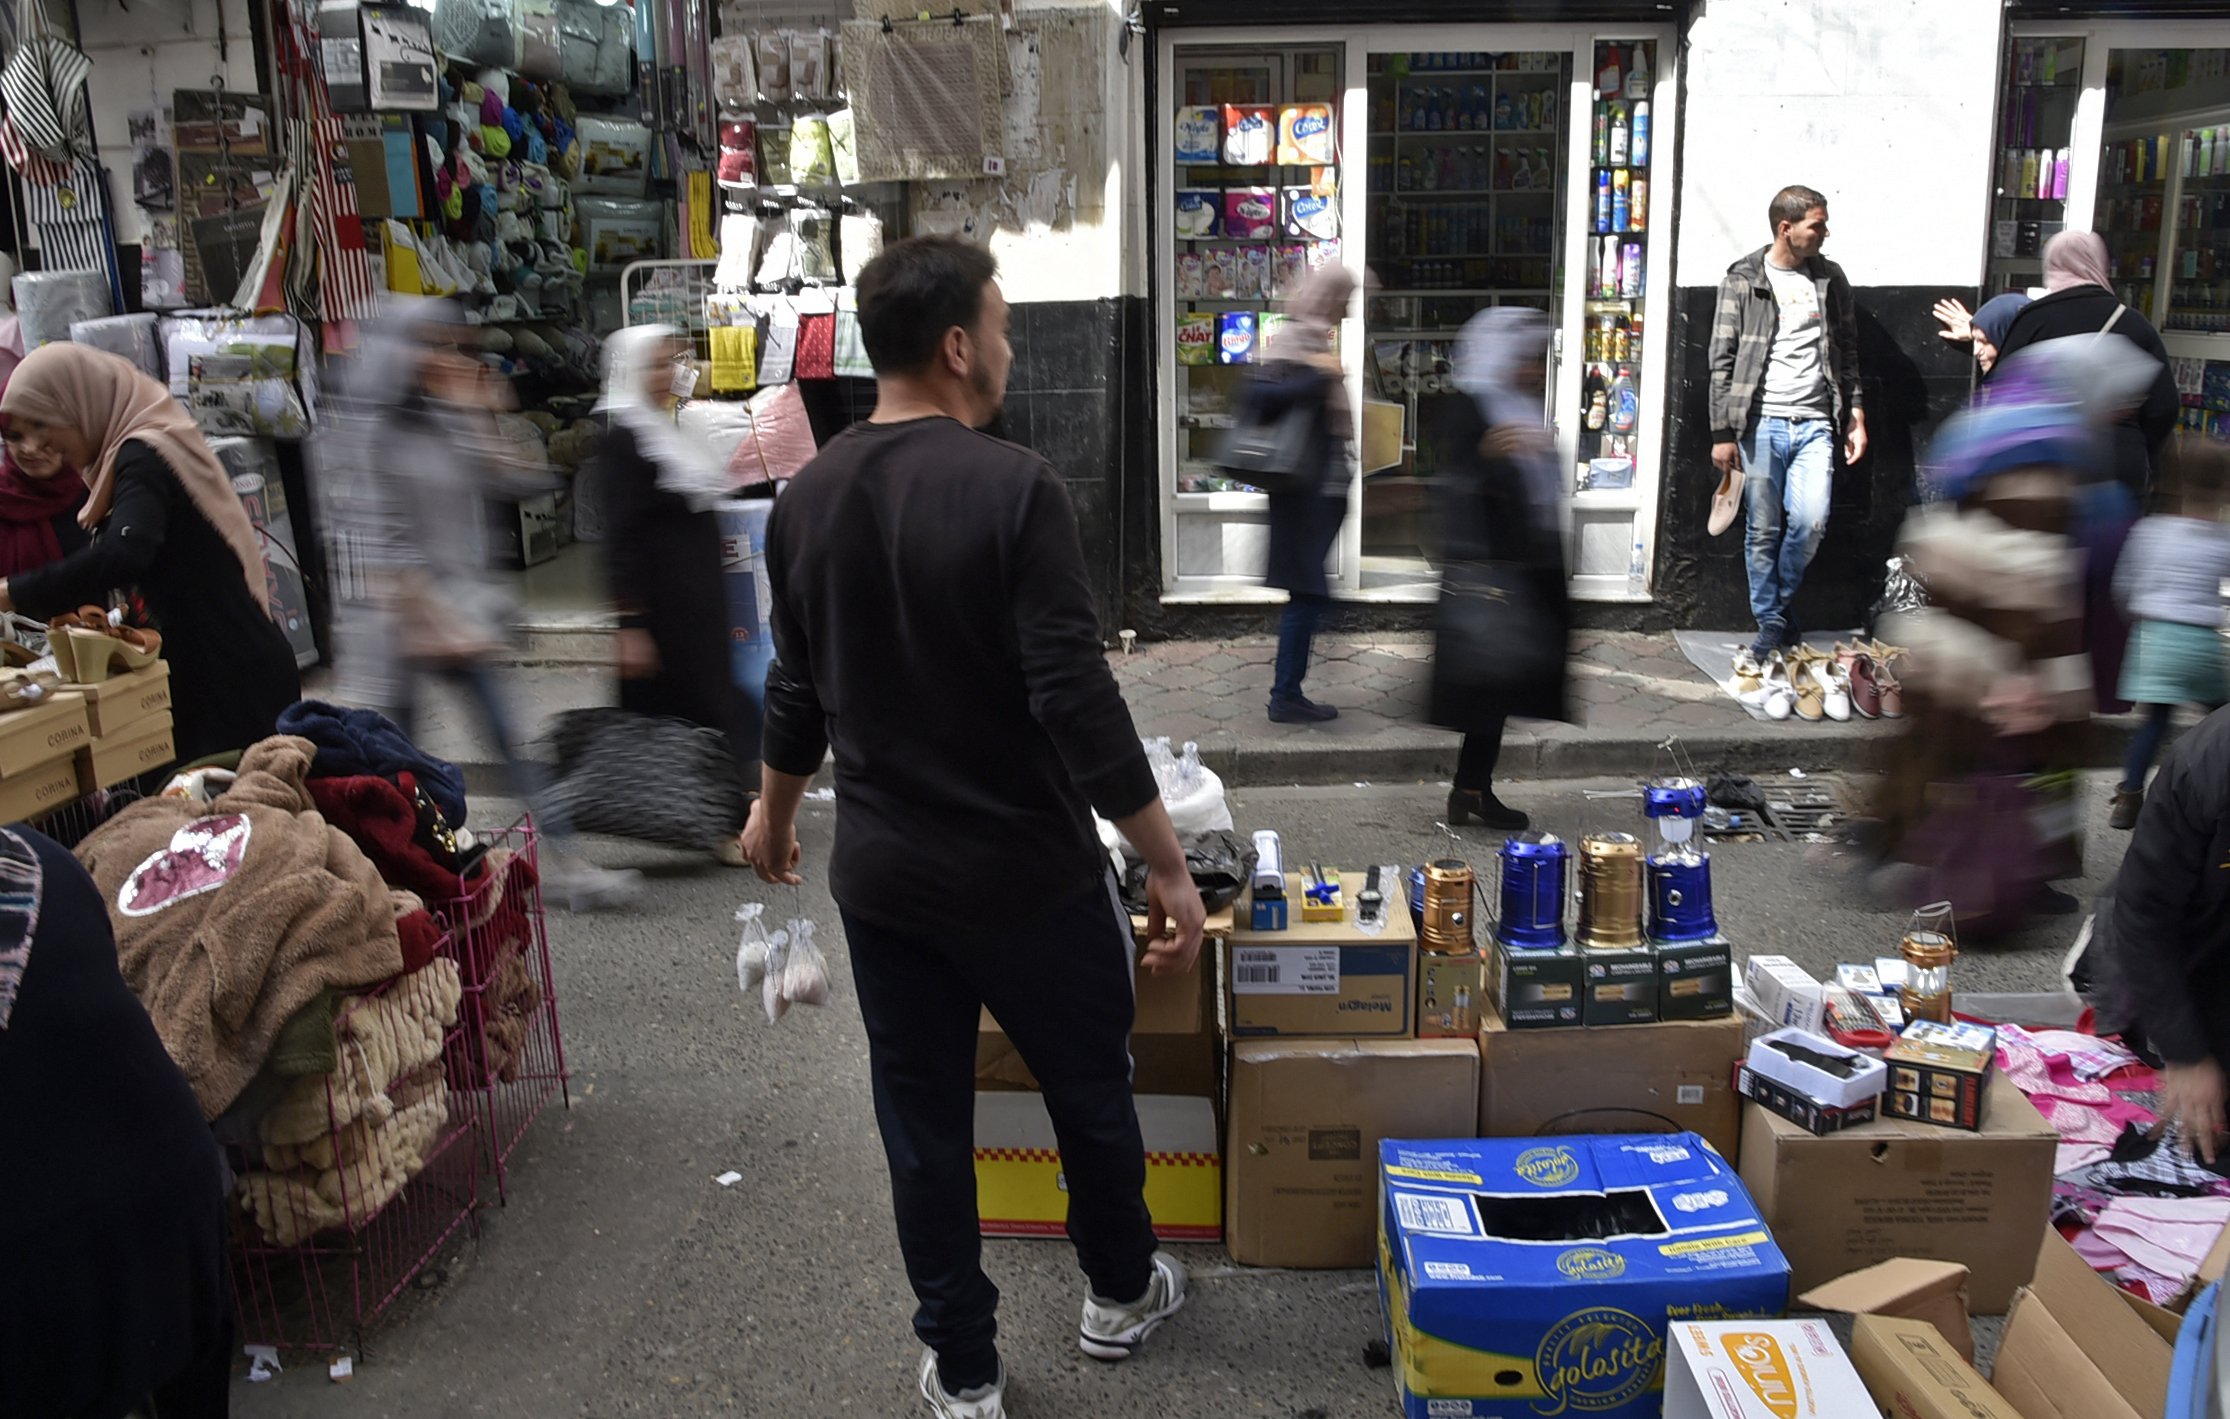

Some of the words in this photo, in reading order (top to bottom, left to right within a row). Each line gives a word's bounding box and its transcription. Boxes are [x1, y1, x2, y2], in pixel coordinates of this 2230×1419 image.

[141, 690, 168, 709] CORINA
[47, 725, 85, 747] CORINA
[138, 742, 170, 762] CORINA
[35, 776, 72, 800] CORINA
[1338, 999, 1392, 1013] Melagyn
[1688, 1324, 1714, 1357] SWEET
[1530, 1336, 1664, 1416] golosita
